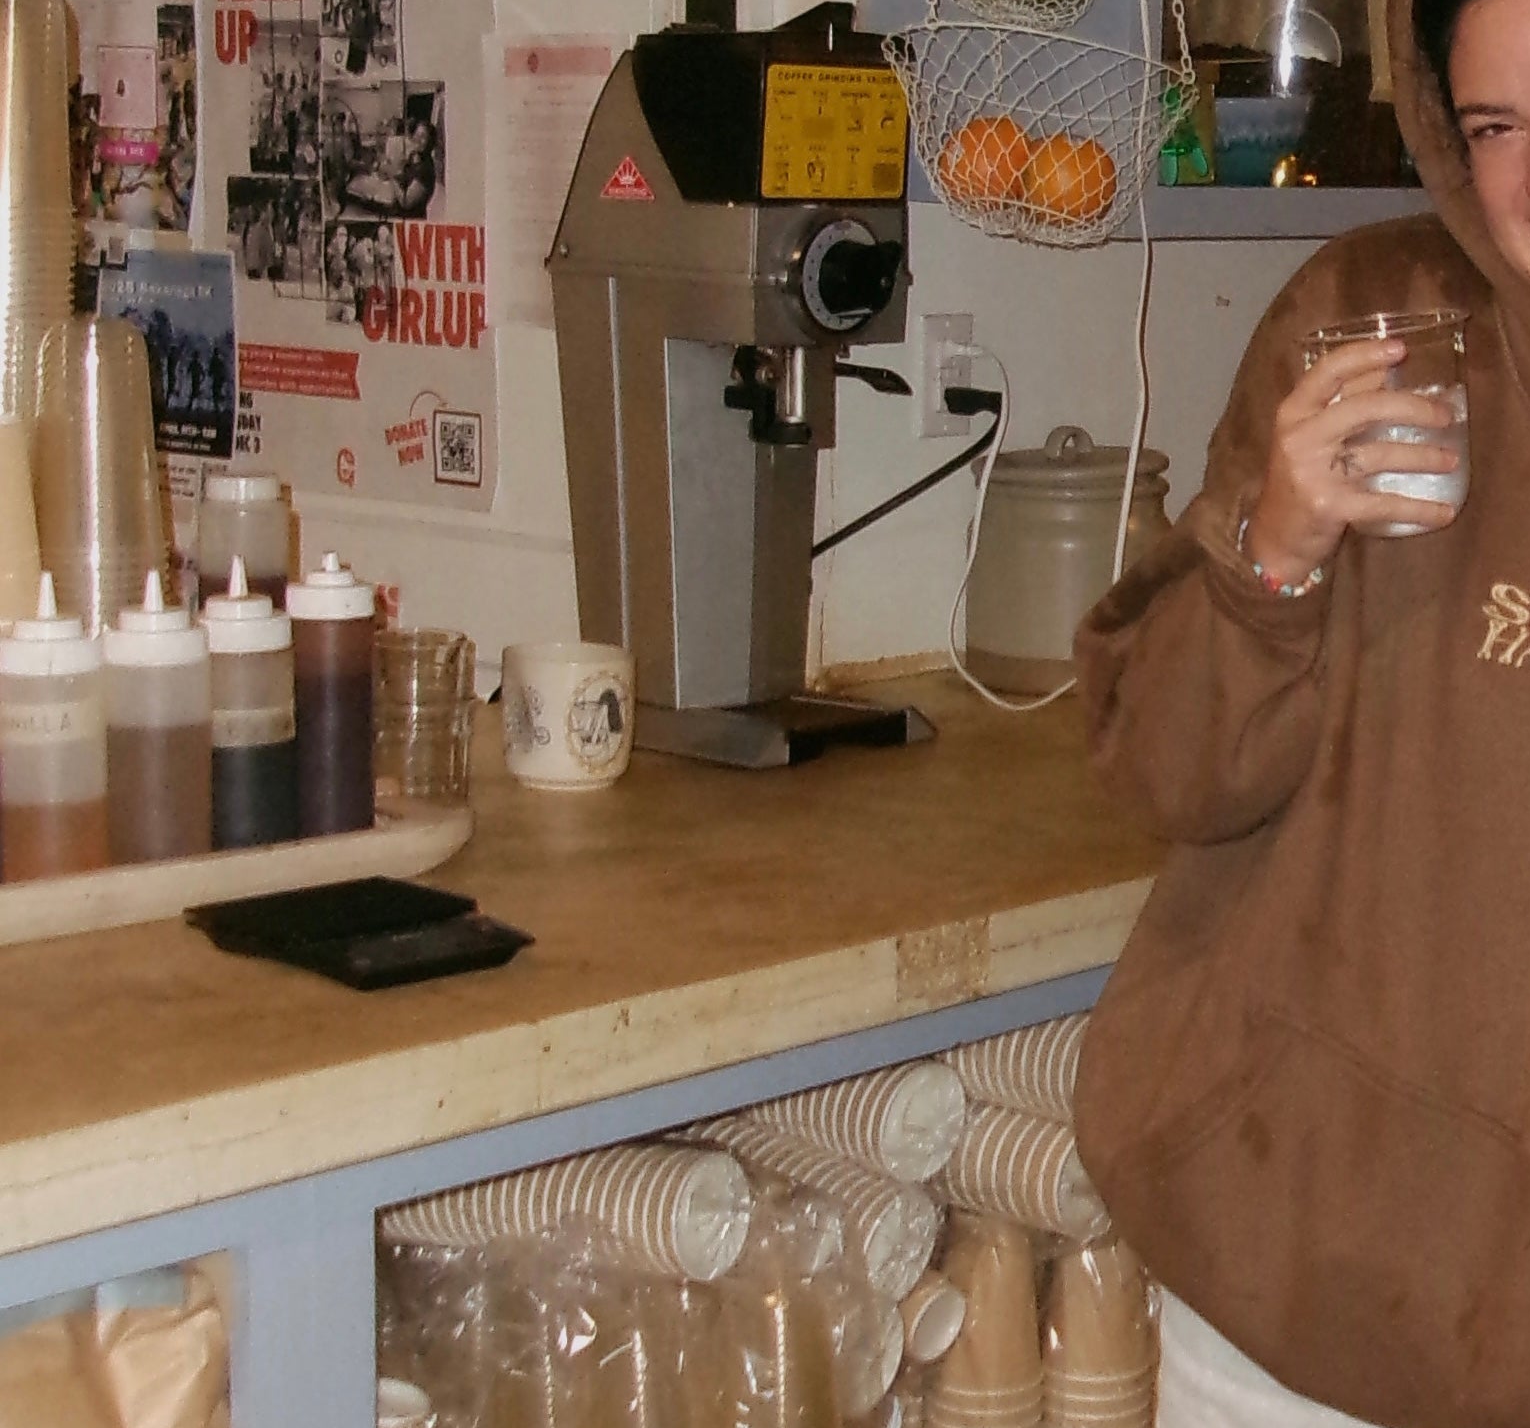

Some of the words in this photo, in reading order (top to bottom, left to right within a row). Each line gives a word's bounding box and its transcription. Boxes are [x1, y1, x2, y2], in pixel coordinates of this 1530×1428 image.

[214, 7, 258, 65] UP
[396, 223, 487, 284] WITH
[362, 285, 488, 349] GIRLUP
[385, 418, 427, 446] DONATE
